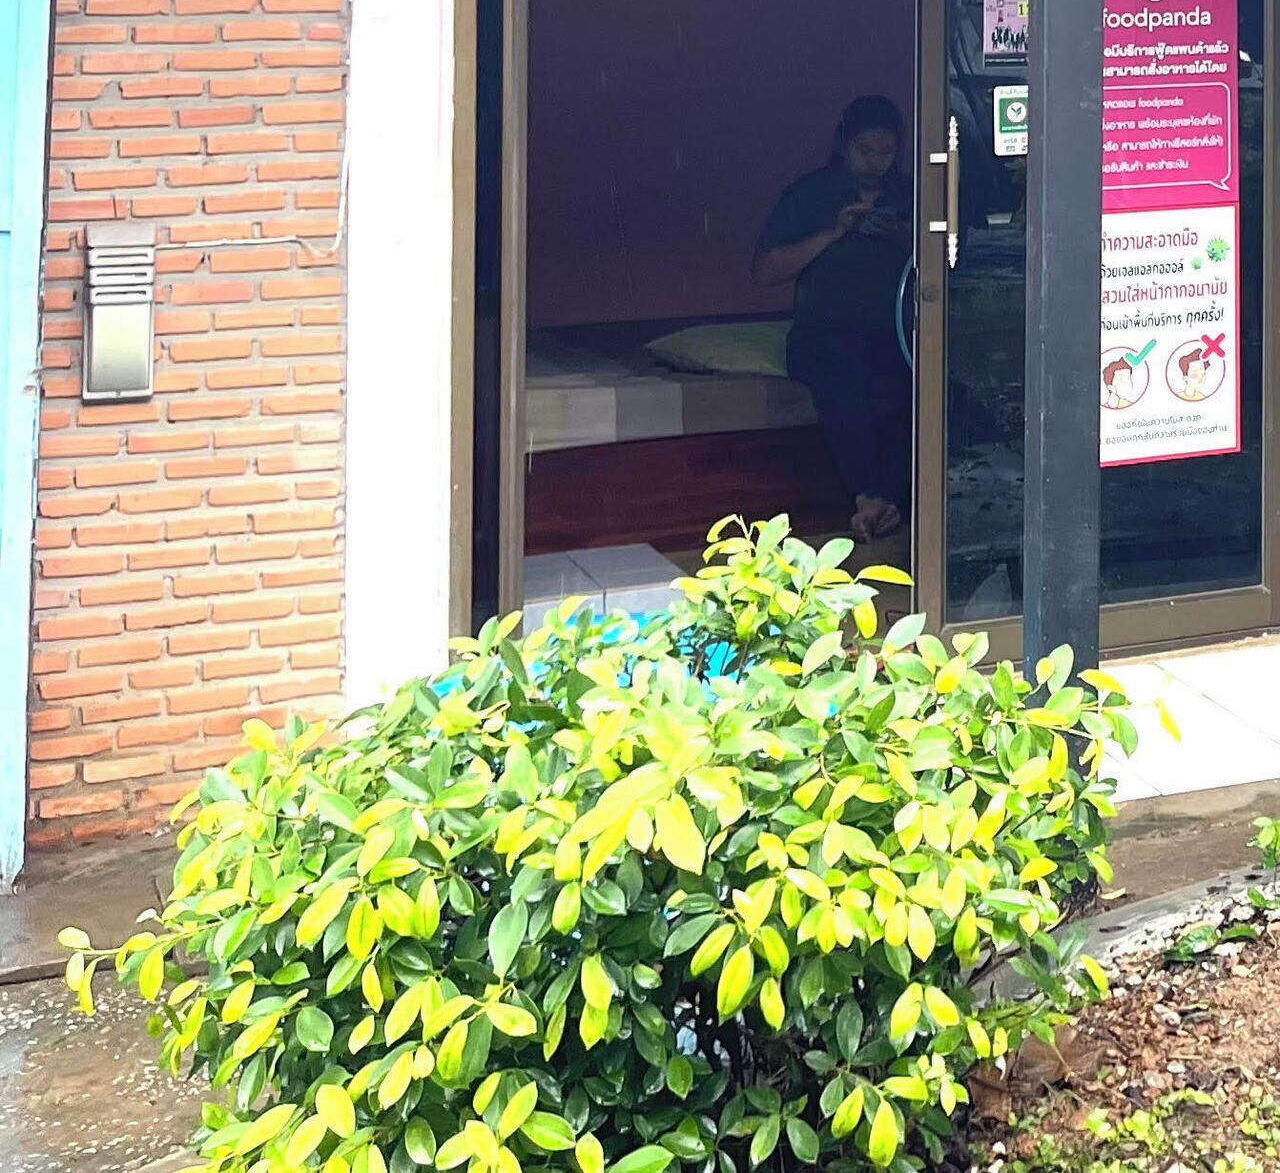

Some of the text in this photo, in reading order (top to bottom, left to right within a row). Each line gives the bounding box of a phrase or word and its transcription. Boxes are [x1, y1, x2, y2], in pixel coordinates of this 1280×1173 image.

[1103, 6, 1211, 32] foodpanda
[1103, 58, 1227, 77] สามารถสั่งอาหารได้โดย
[1138, 96, 1184, 109] foodpanda
[1101, 276, 1228, 304] สวมใส่หน้ากากอนามัย
[1186, 300, 1224, 328] ทุกครั้ง!
